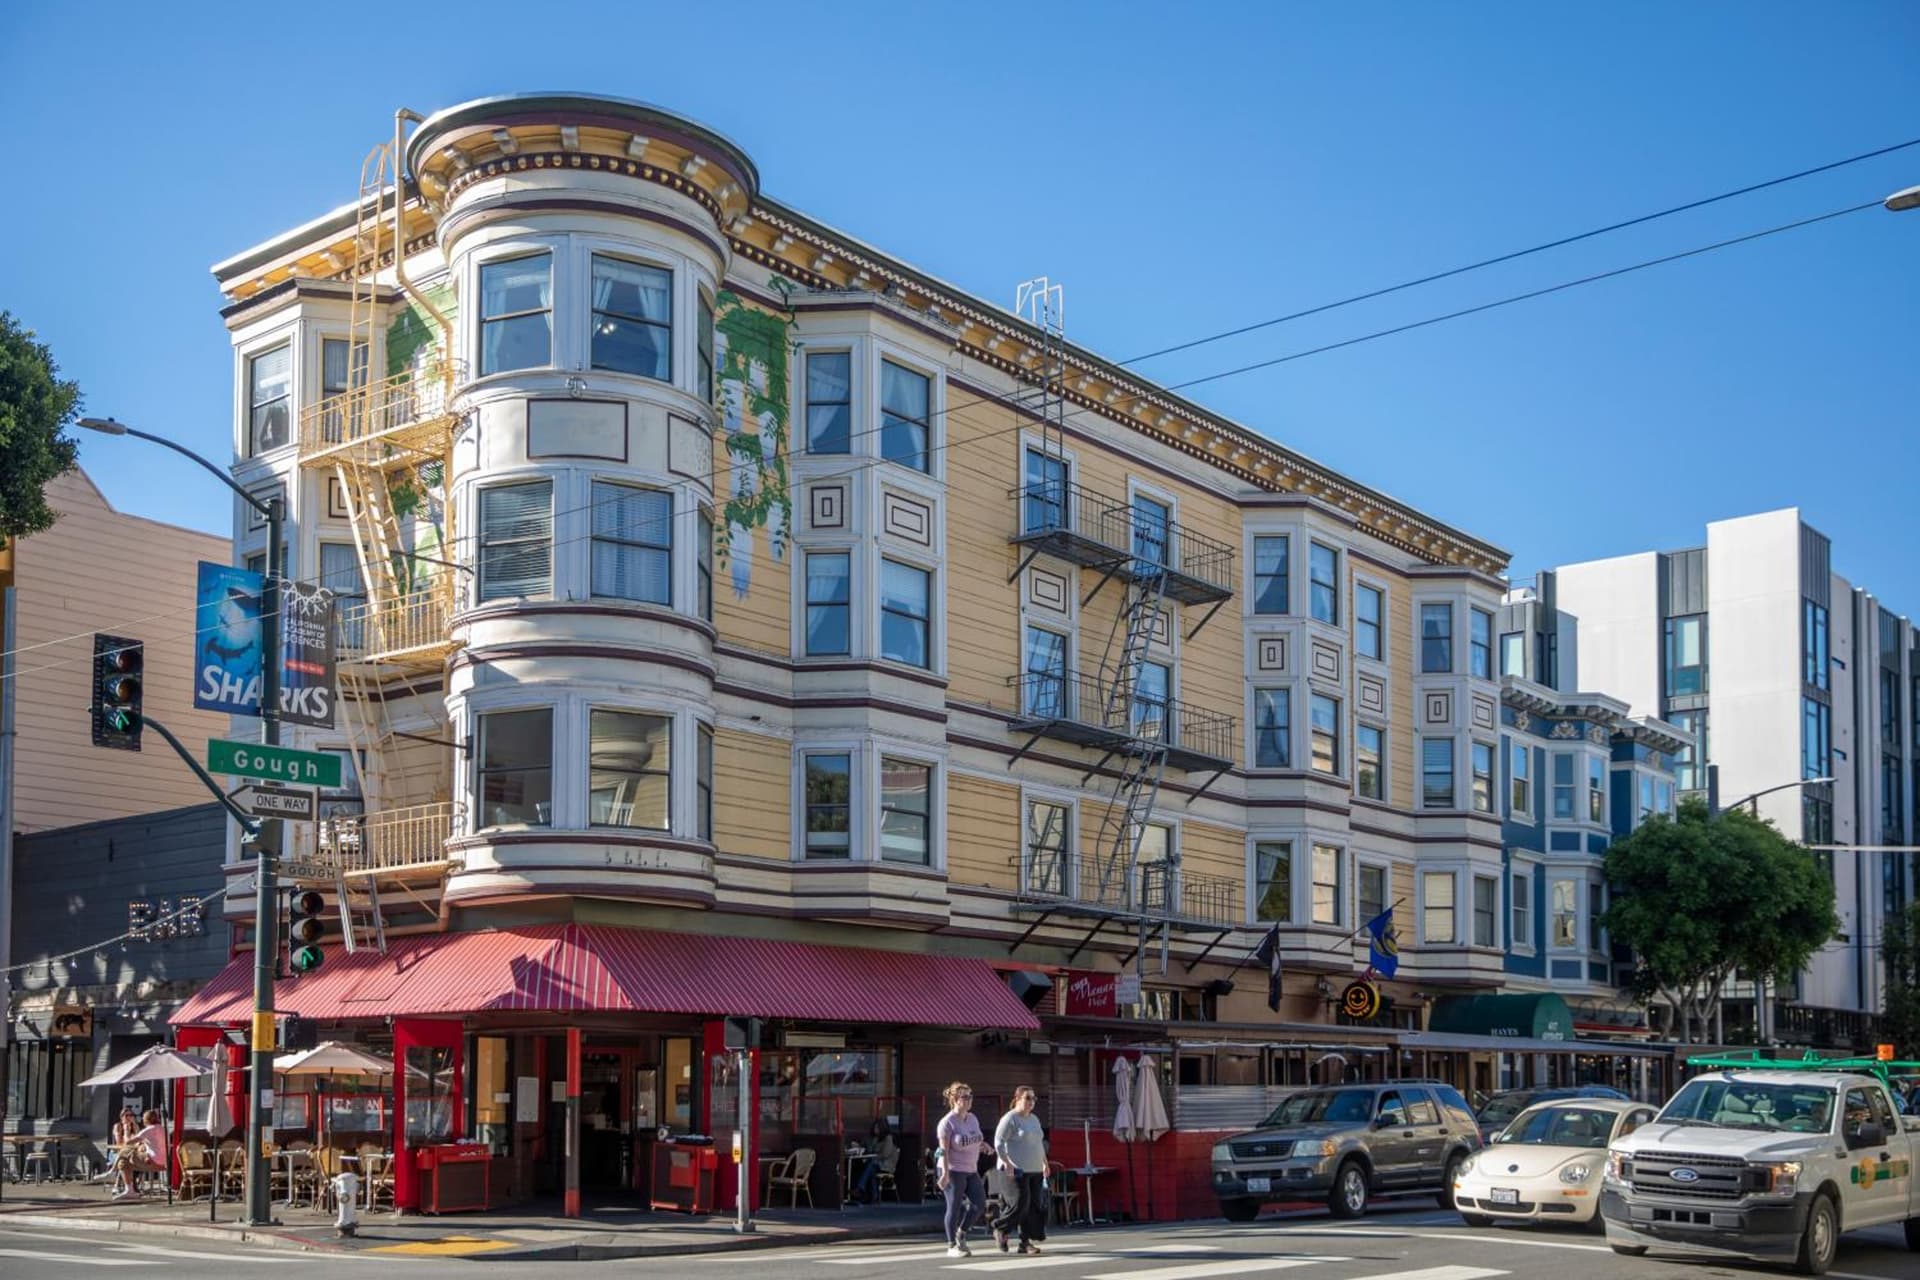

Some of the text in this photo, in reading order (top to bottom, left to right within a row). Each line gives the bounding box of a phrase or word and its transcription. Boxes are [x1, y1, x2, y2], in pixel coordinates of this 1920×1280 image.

[234, 750, 318, 779] Gough
[256, 795, 307, 810] ONE WAY
[287, 865, 336, 879] GOUGH
[128, 897, 205, 939] BAR
